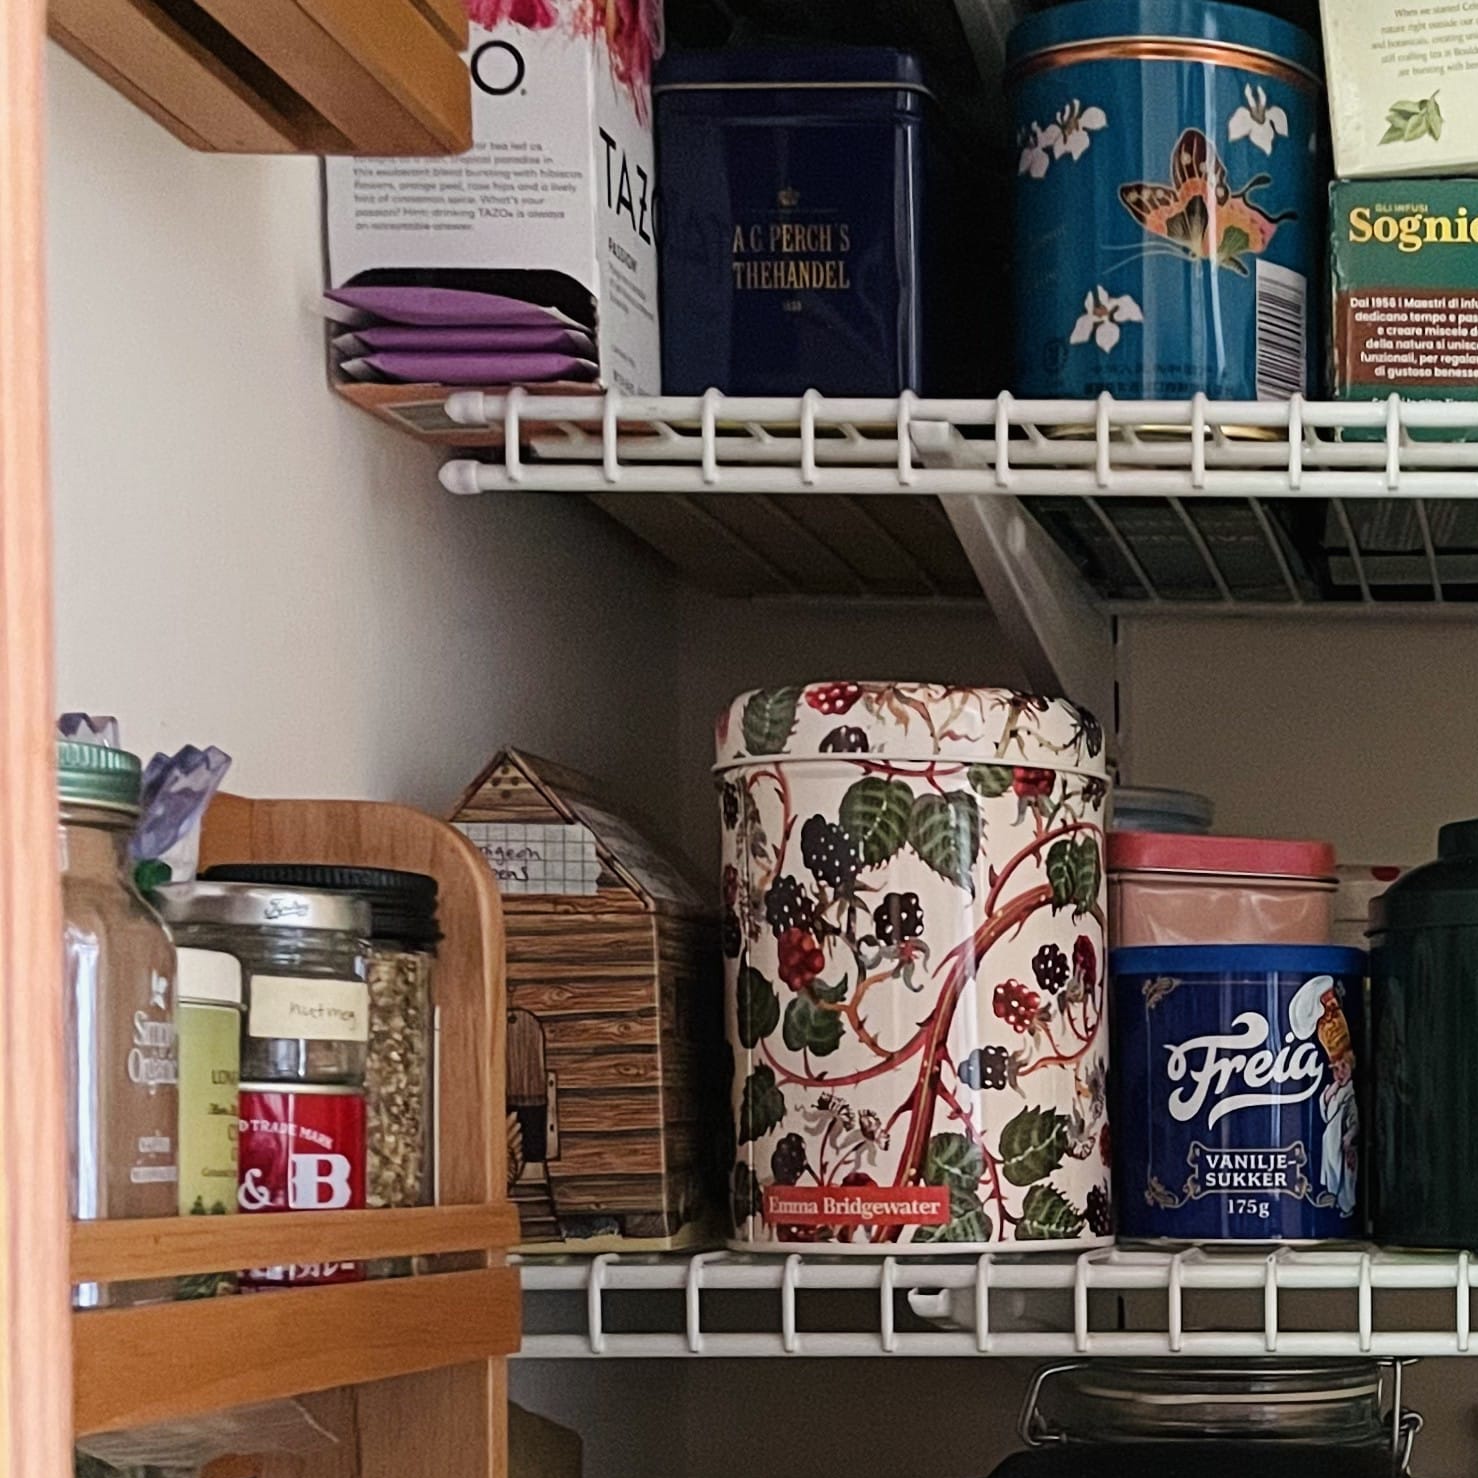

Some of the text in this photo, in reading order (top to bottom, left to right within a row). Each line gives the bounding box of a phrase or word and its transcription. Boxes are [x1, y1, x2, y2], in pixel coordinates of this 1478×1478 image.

[599, 126, 657, 246] TAZ
[770, 223, 850, 252] PERCH'S
[733, 261, 850, 289] THEHANDEL
[1351, 298, 1369, 308] Dal
[1404, 297, 1446, 309] Maestri
[1448, 298, 1459, 309] di
[1355, 311, 1408, 322] dedicano
[1410, 312, 1447, 325] tempo
[1386, 327, 1423, 336] creare
[1366, 339, 1394, 350] della
[1396, 340, 1434, 350] natura
[1436, 339, 1446, 350] si
[1360, 352, 1418, 364] funzionali,
[1420, 354, 1438, 366] per
[1374, 366, 1386, 377] di
[1388, 367, 1432, 379] gustoso
[290, 1001, 356, 1030] nutmeg
[1162, 1012, 1323, 1131] Freia
[252, 1119, 333, 1149] TRADE MARK
[1206, 1154, 1297, 1172] VANILJE-
[238, 1154, 352, 1209] & B
[1205, 1172, 1287, 1187] SUKKER
[768, 1196, 941, 1217] Emma Bridgewater
[1227, 1199, 1270, 1218] 175g
